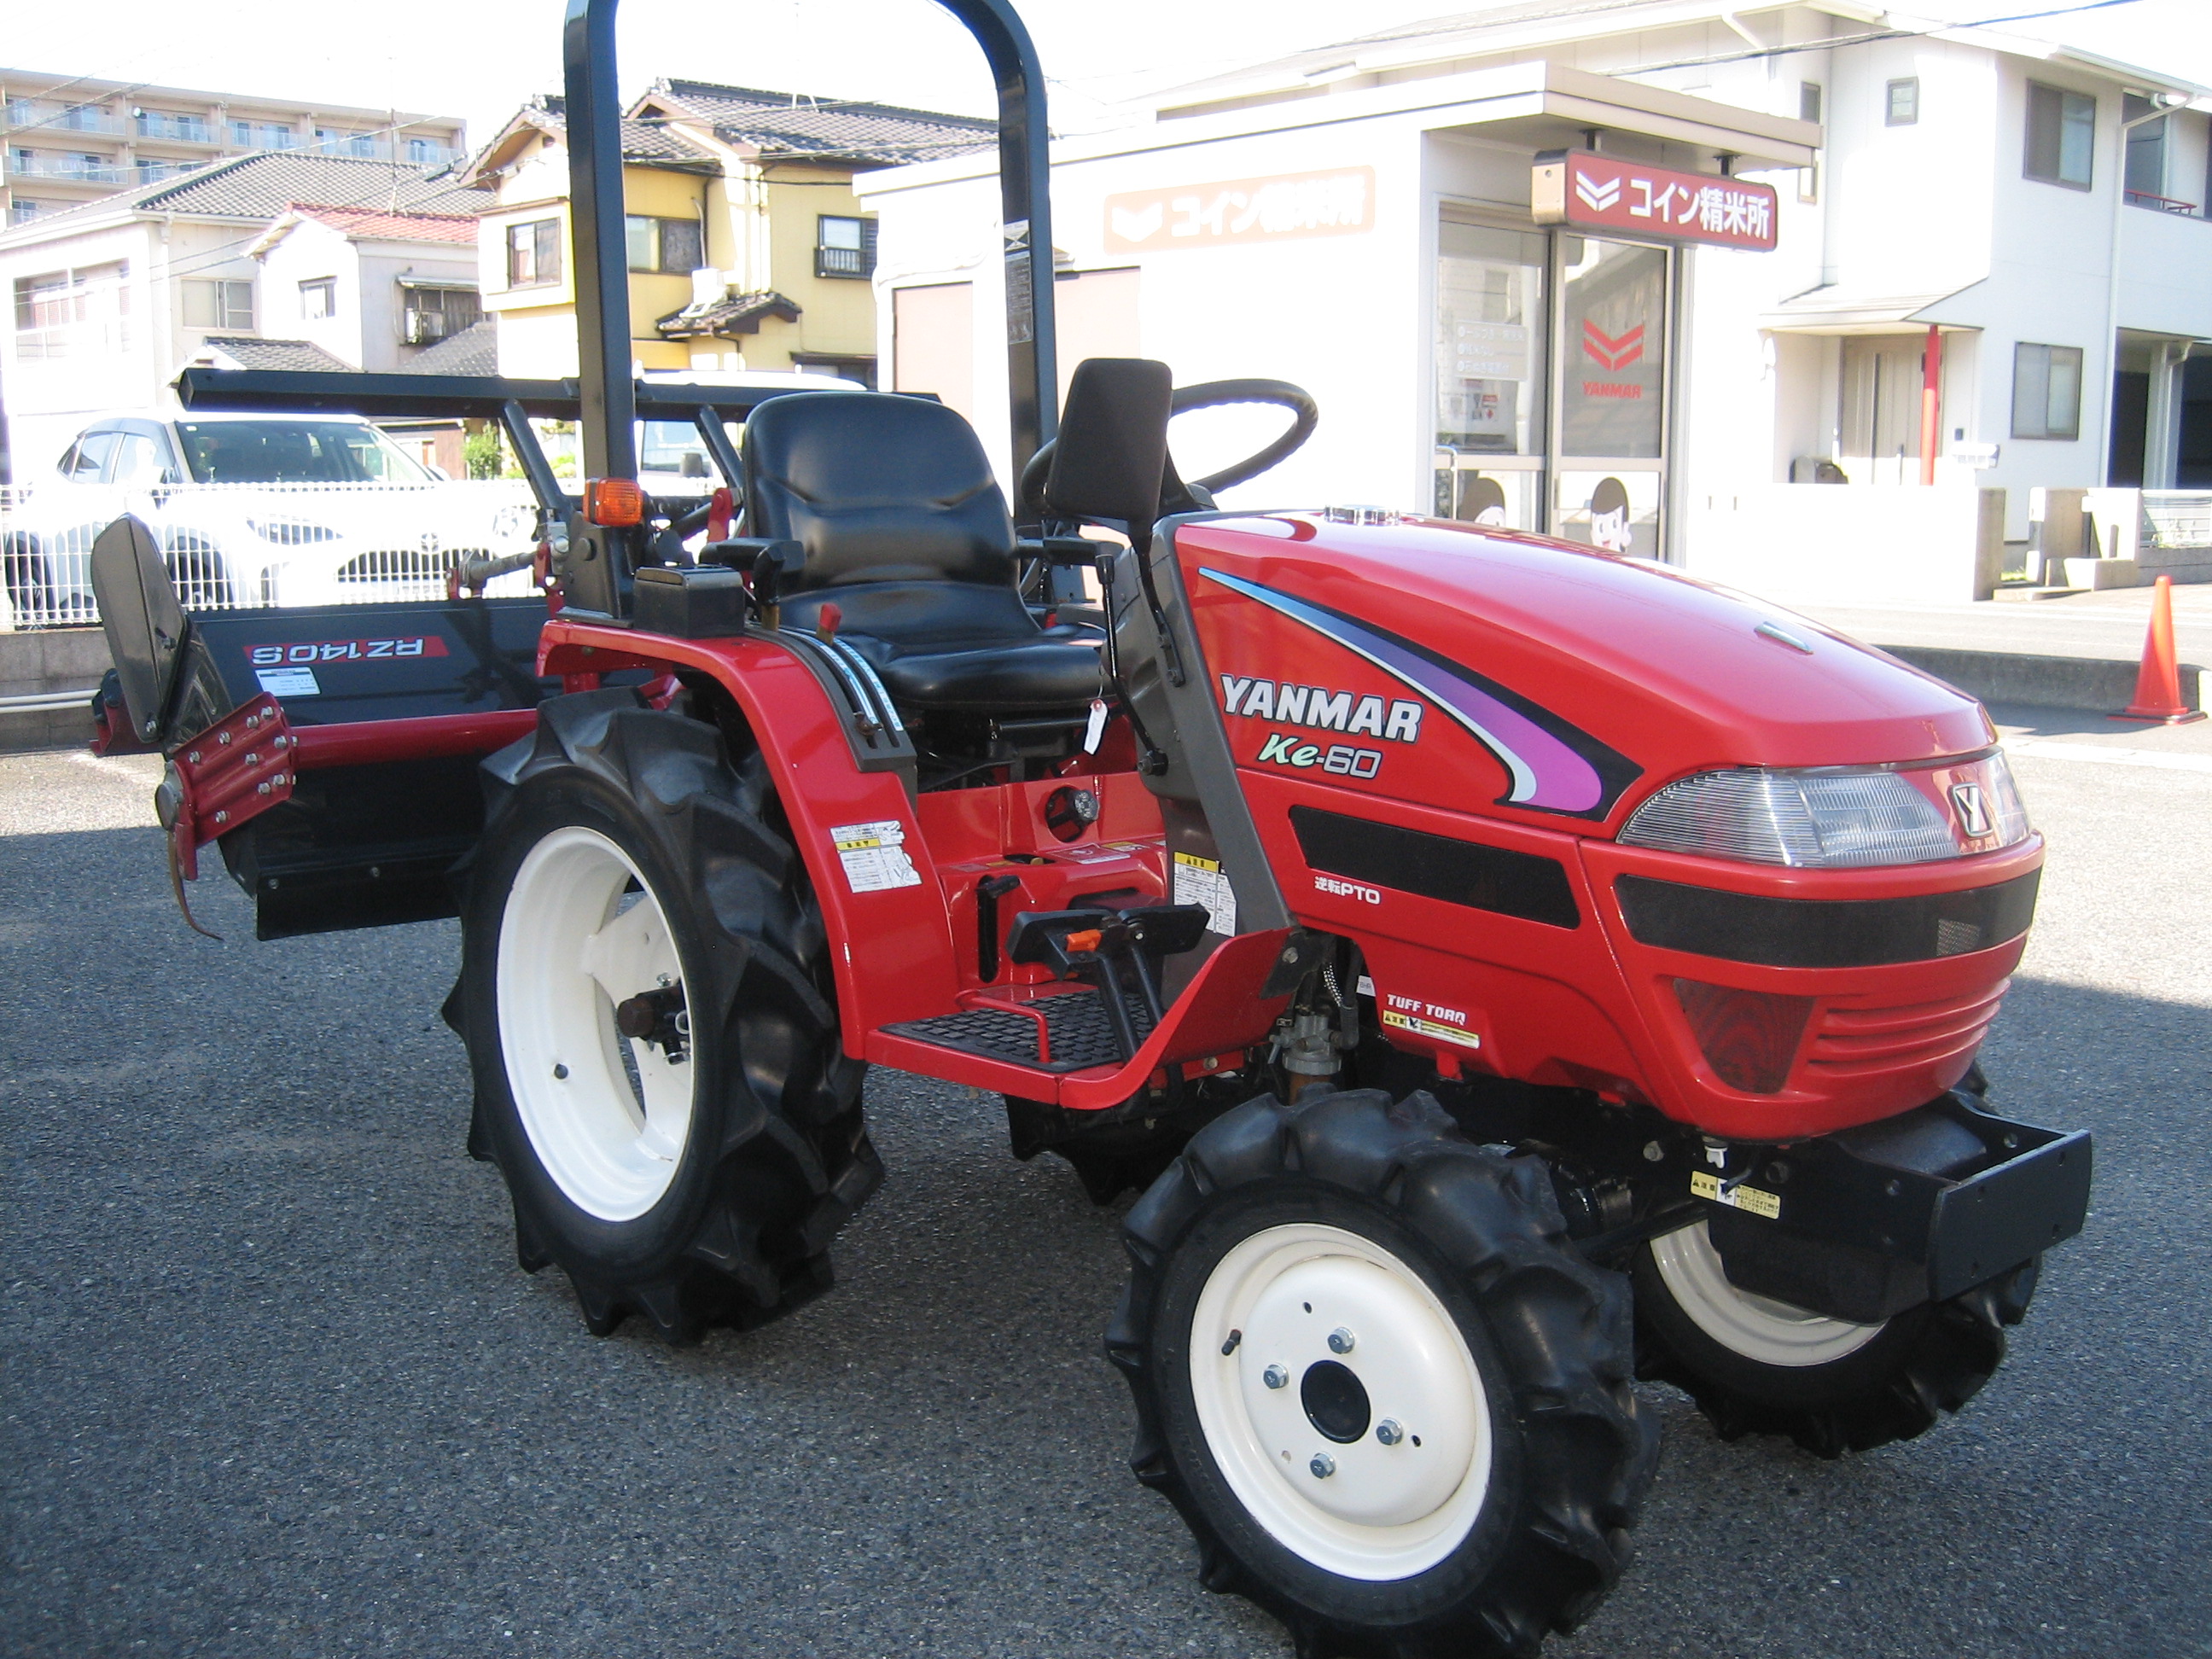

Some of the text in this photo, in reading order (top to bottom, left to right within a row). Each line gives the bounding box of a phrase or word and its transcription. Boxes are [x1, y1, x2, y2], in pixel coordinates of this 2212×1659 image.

[1629, 178, 1770, 240] コイン精米所
[1583, 381, 1643, 399] YANMAR
[252, 638, 424, 665] RZ140S
[1220, 673, 1423, 743] YANMAR
[1257, 733, 1382, 780] Ke-60
[1314, 876, 1381, 905] 逆転PTO
[1387, 993, 1423, 1012] TUFF
